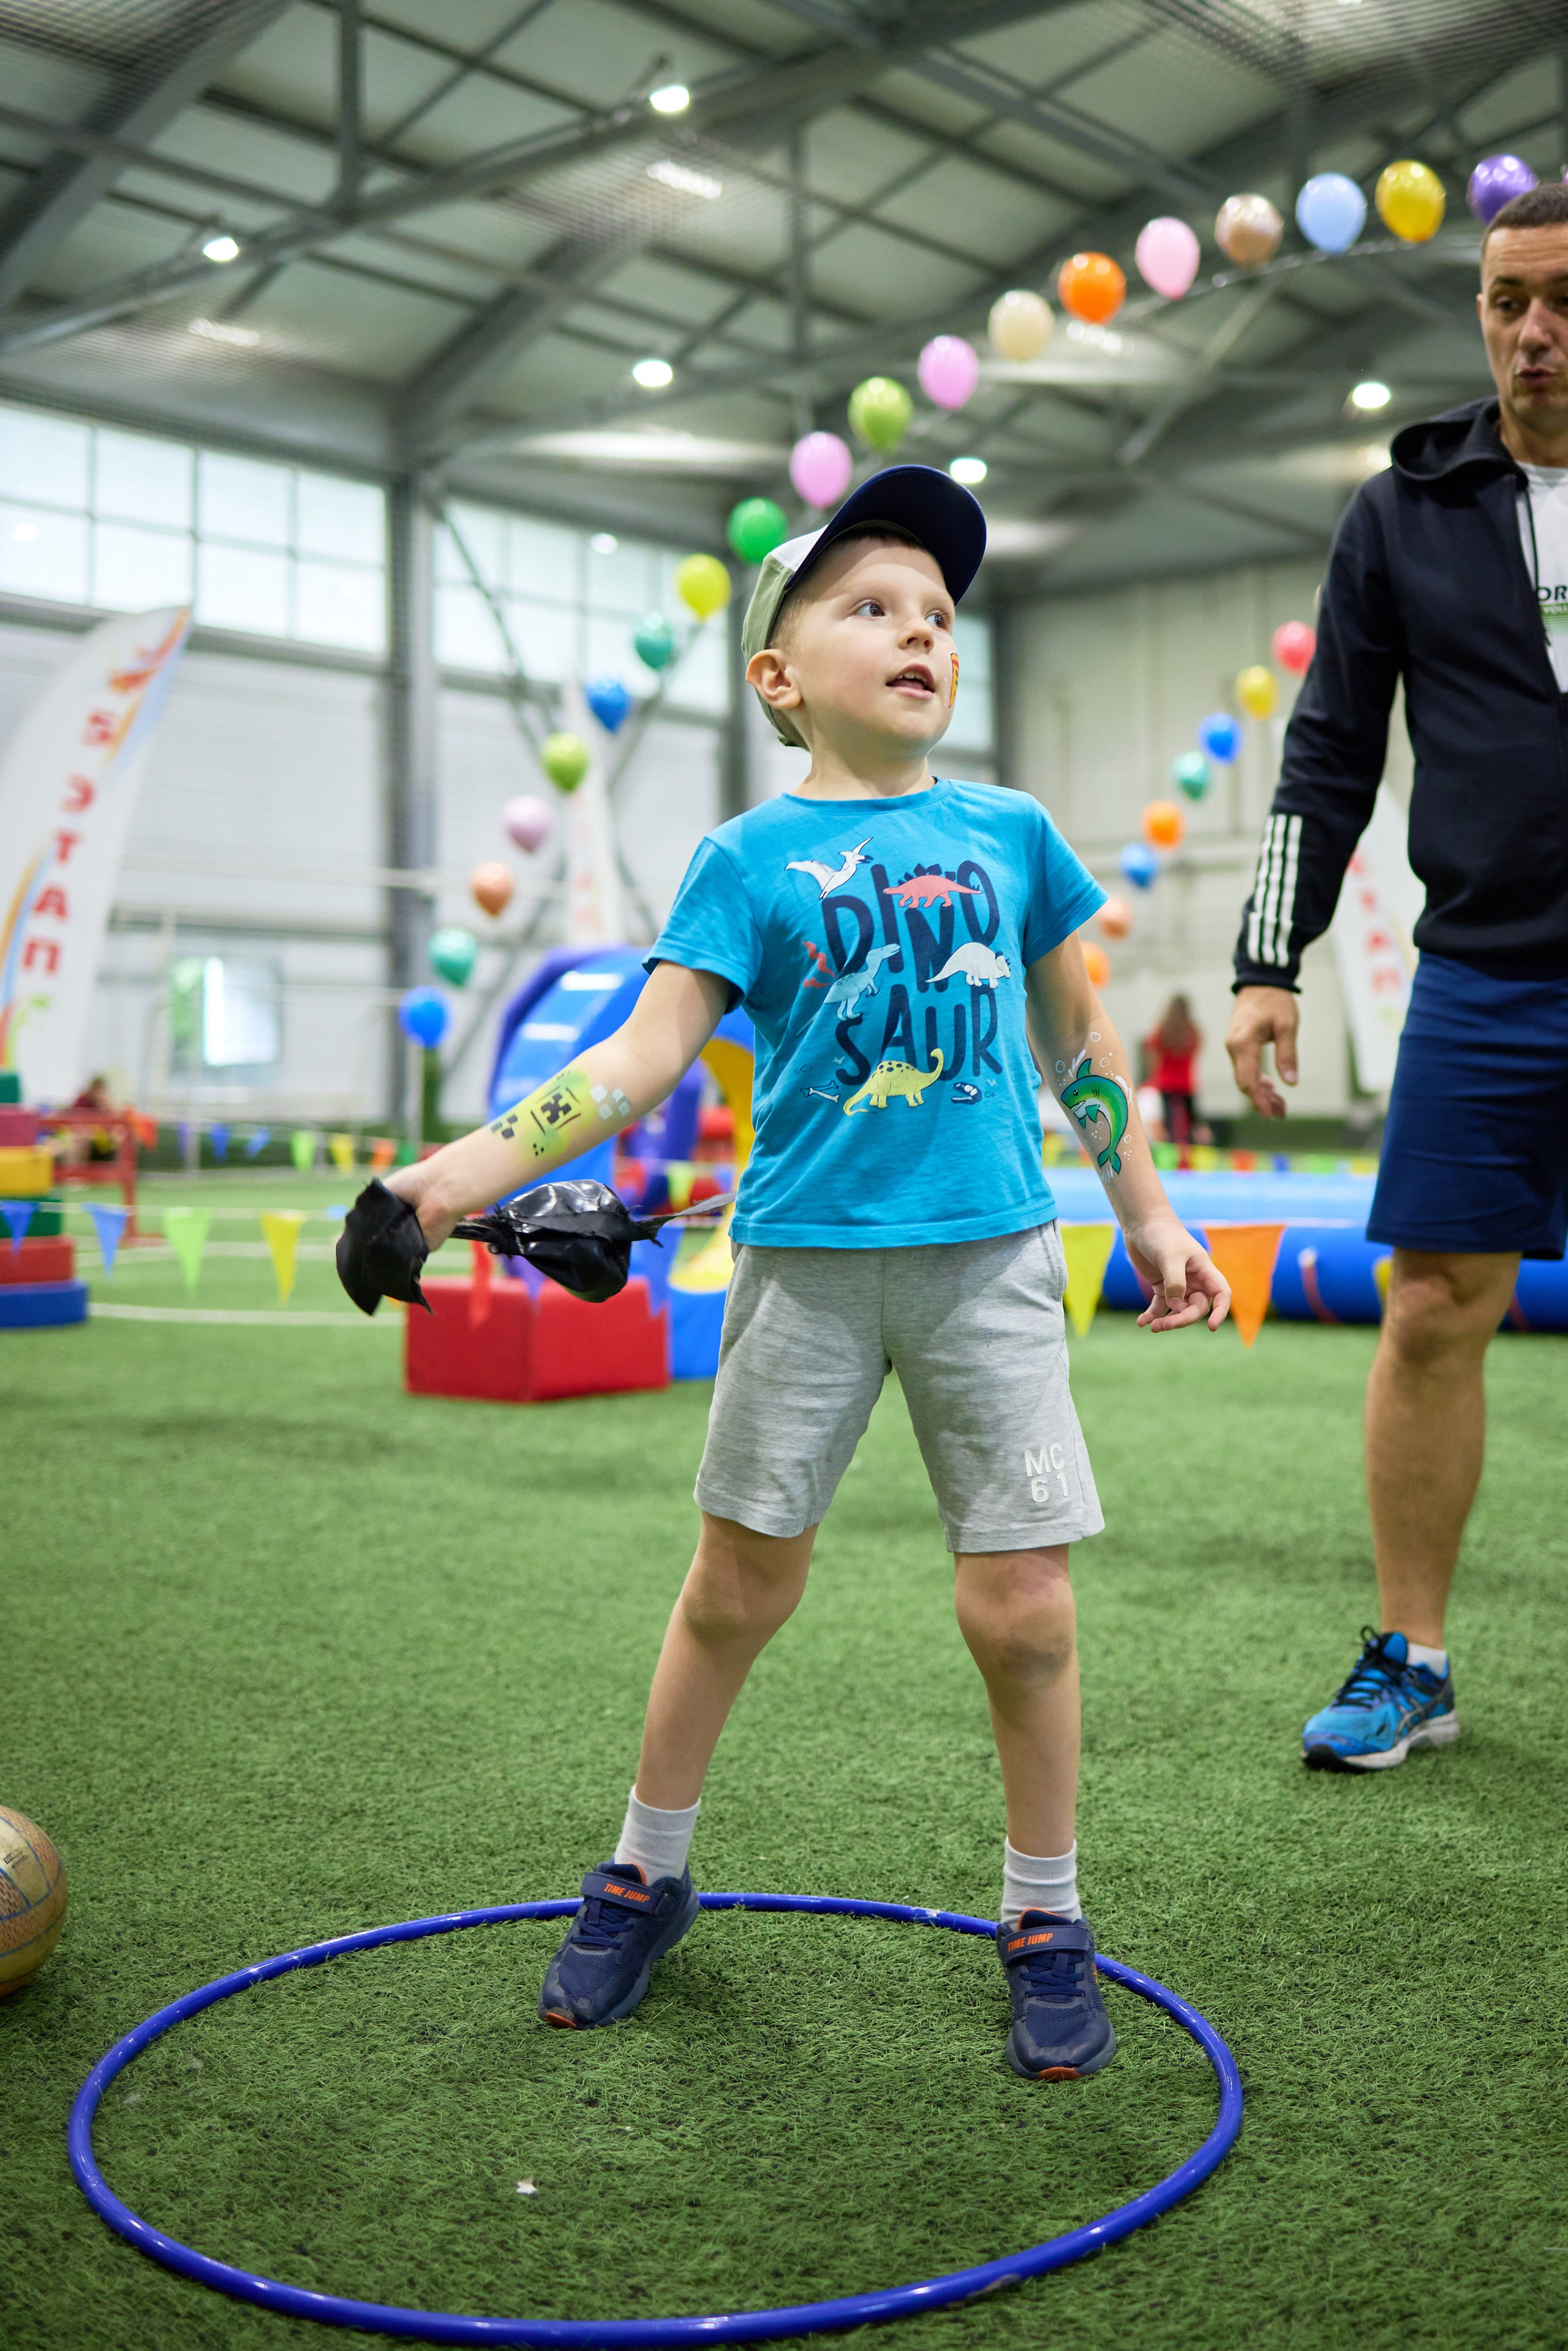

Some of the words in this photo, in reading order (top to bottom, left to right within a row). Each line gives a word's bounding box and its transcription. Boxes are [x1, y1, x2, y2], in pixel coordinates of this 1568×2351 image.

[821, 860, 1000, 992] DINO
[835, 984, 1003, 1085] SAUR
[1023, 1441, 1066, 1477] MC
[1031, 1471, 1069, 1503] 61
[604, 1883, 626, 1896] TIME
[624, 1890, 650, 1903] JUMP
[1007, 1937, 1027, 1953] TIME
[1027, 1932, 1054, 1946] JUMP
